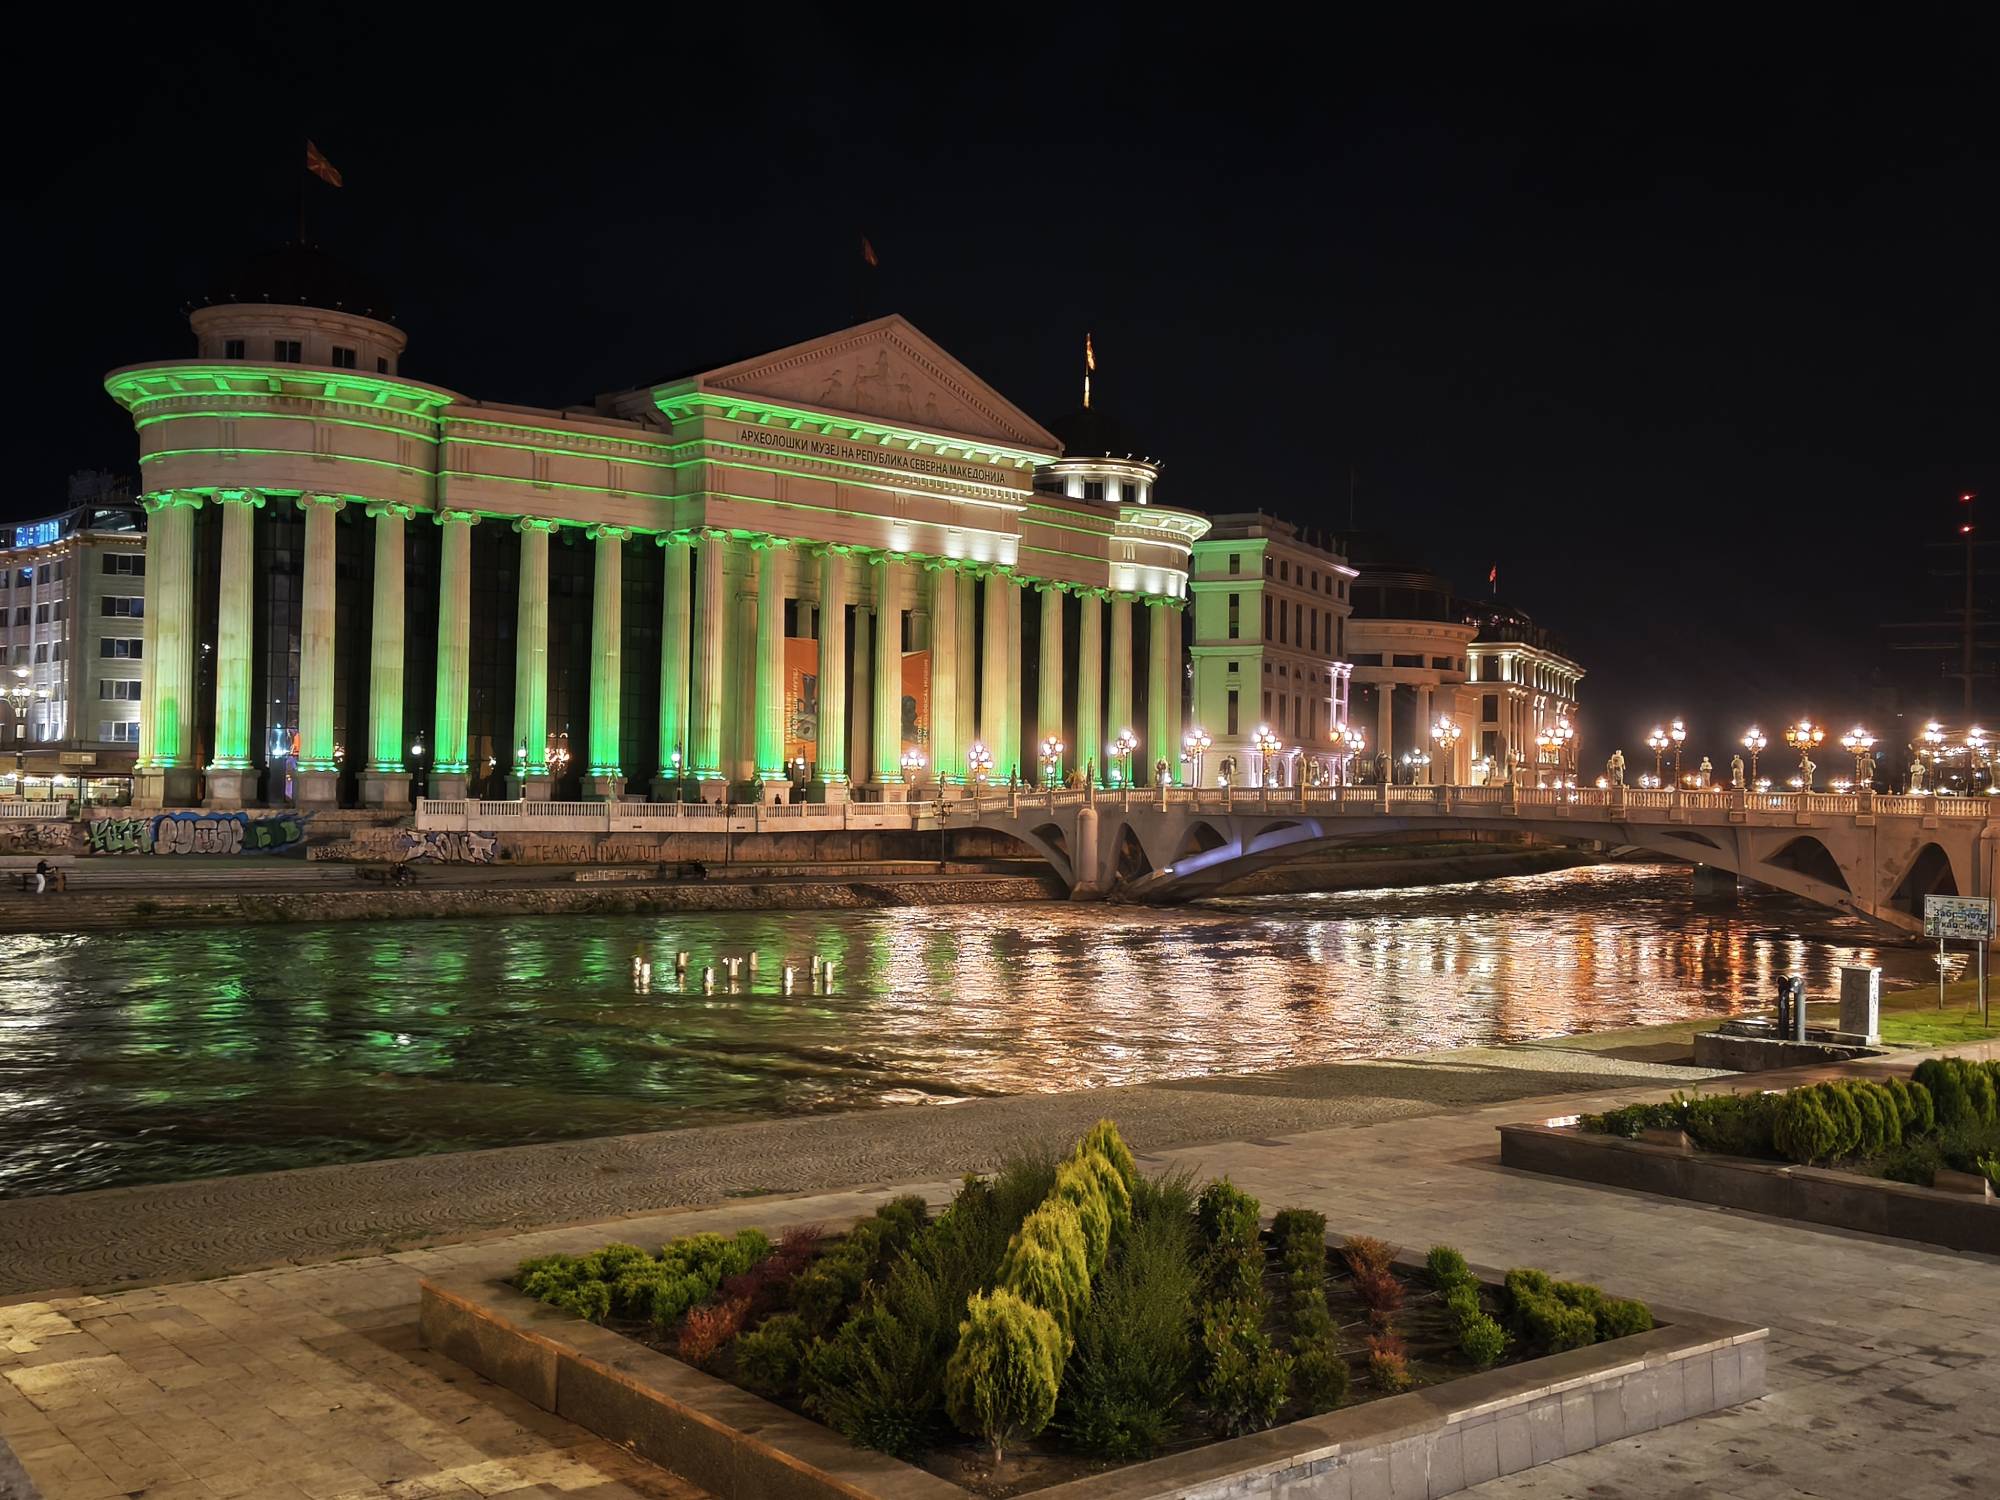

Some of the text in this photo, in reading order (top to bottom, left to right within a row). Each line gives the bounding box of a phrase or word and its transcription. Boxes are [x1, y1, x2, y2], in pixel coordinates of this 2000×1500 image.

[741, 430, 1005, 483] АРХЕОЛОШКИ МУЗЕЈ НА РЕПУБЛИКА СЕВЕРНА МАКЕДОНИЈА
